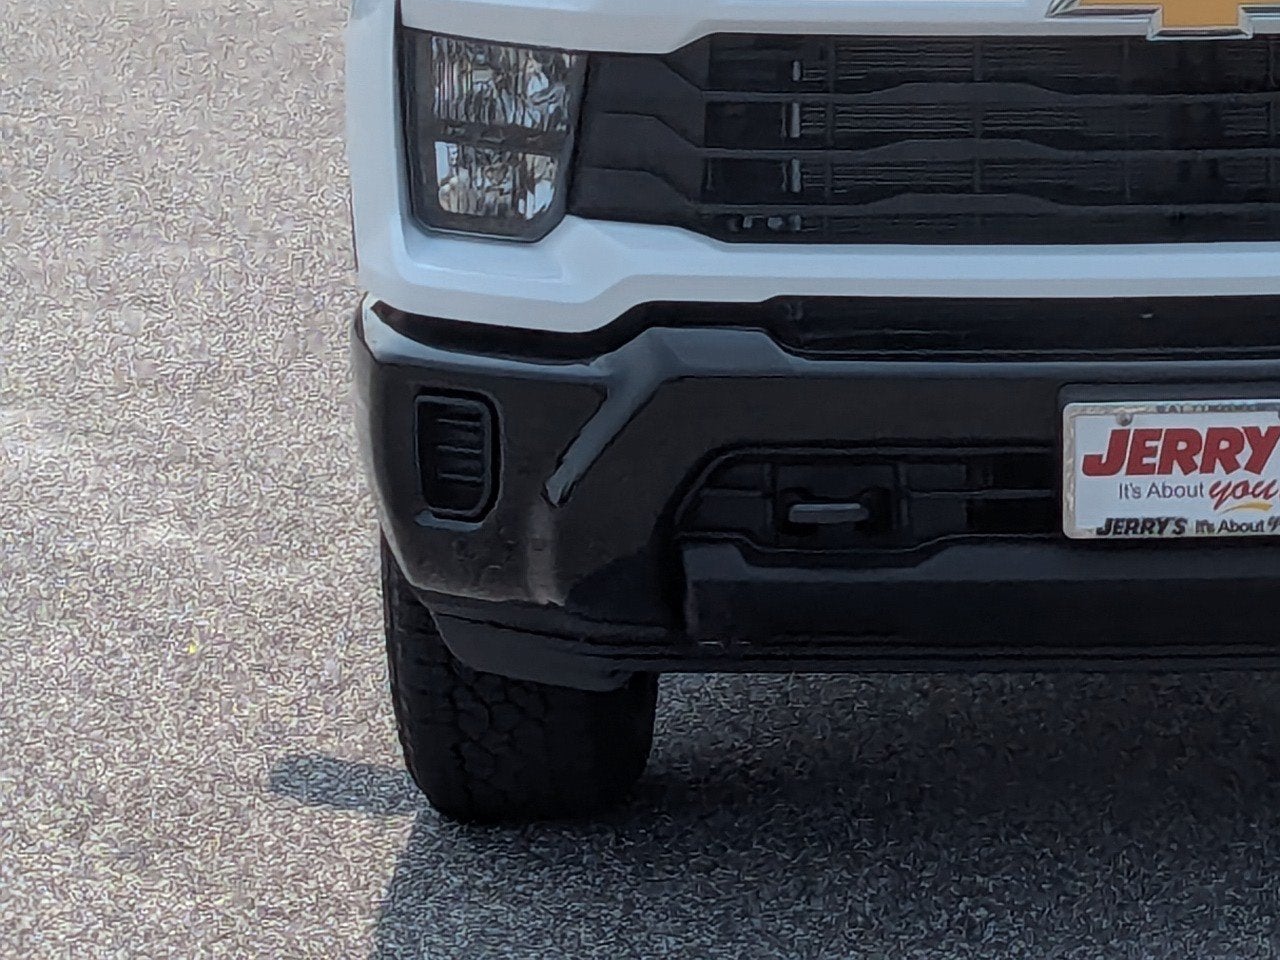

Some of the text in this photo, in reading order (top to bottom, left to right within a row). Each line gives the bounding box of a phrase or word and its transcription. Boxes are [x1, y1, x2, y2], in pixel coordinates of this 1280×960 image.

[1118, 482, 1142, 500] It's
[1146, 482, 1205, 500] About
[1096, 516, 1188, 536] JERRY'S
[1195, 519, 1215, 533] It's
[1218, 518, 1265, 533] About
